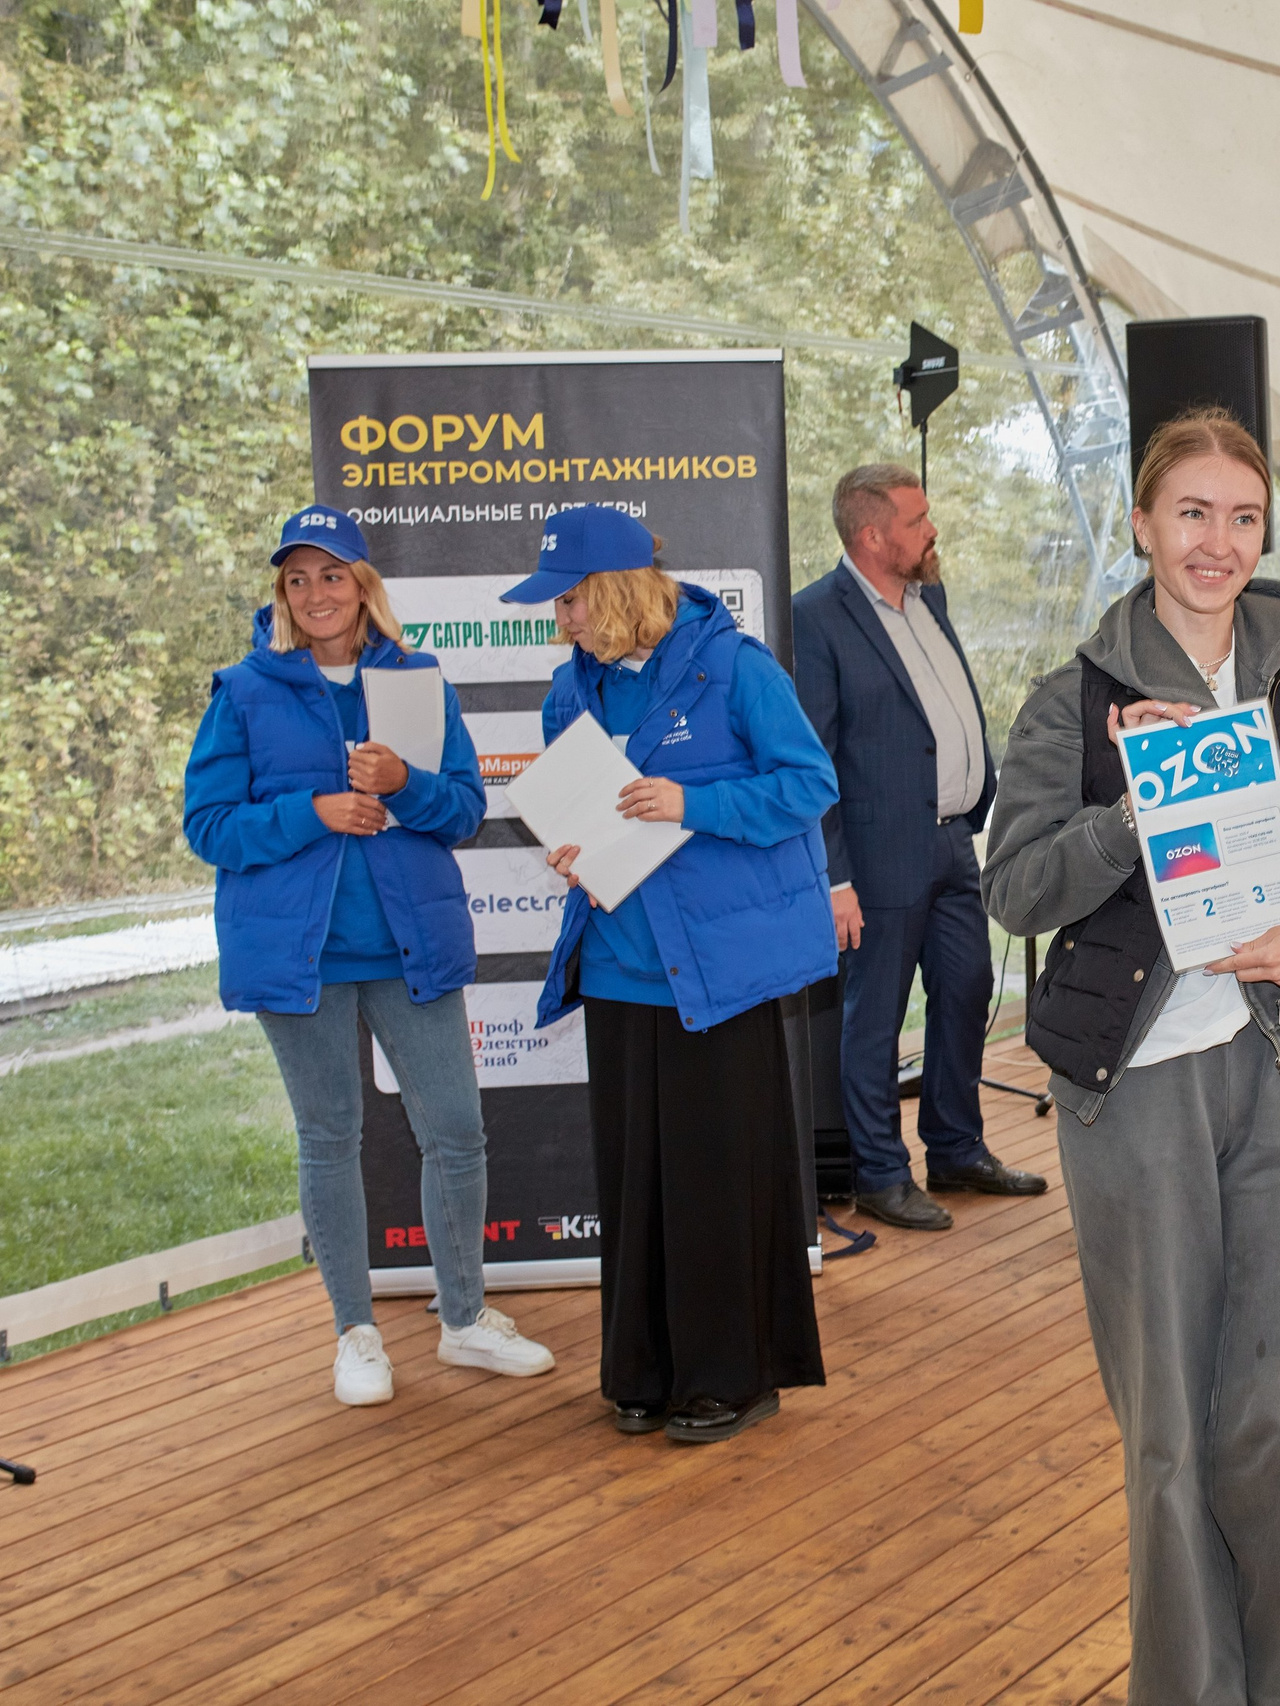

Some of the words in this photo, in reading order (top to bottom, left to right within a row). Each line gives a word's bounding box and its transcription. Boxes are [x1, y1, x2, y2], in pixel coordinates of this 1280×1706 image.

[341, 413, 545, 456] ФОРУМ
[341, 454, 757, 488] ЭЛЕКТРОМОНТАЖНИКОВ
[300, 513, 337, 530] SDS
[347, 503, 523, 527] ОФИЦИАЛЬНЫЕ
[1132, 709, 1271, 810] OZON
[1166, 843, 1201, 861] OZON
[1252, 885, 1266, 904] 3
[1202, 898, 1216, 917] 2
[1163, 909, 1173, 926] 1
[471, 1019, 523, 1037] Проф
[471, 1038, 549, 1052] Электро
[474, 1052, 518, 1068] Снаб
[385, 1220, 521, 1248] RENT
